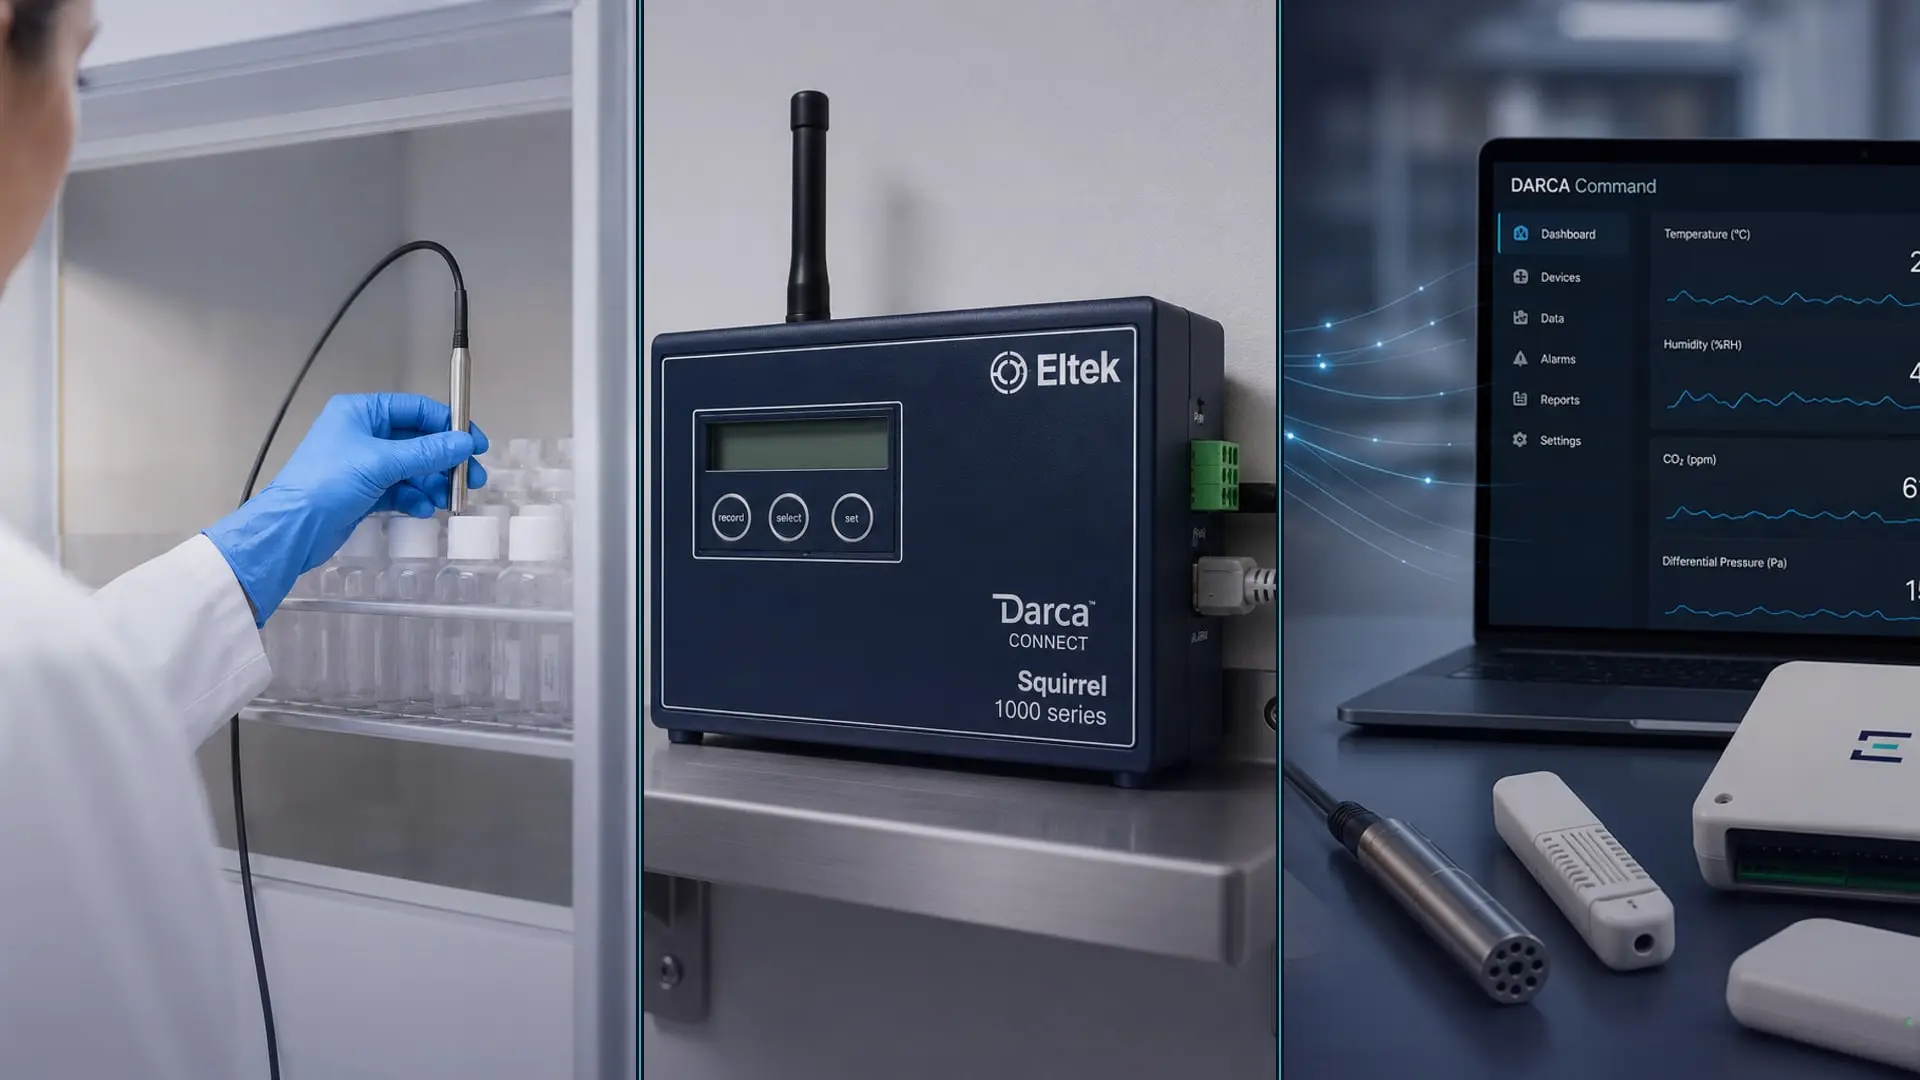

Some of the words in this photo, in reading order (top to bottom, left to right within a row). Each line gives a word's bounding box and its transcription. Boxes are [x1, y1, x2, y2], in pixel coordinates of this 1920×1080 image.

[1511, 177, 1570, 194] DARCA
[1575, 177, 1657, 195] Command
[1541, 228, 1597, 241] Dashboard
[1664, 228, 1728, 242] Temperature
[1540, 271, 1581, 284] Devices
[1540, 312, 1565, 325] Data
[1663, 338, 1708, 353] Humidity
[1711, 339, 1742, 353] (%RH)
[1540, 353, 1577, 366] Alarms
[1037, 350, 1121, 386] Eltek
[1540, 394, 1581, 407] Reports
[1540, 434, 1582, 449] Settings
[1687, 454, 1717, 467] (ppm)
[1902, 476, 1920, 500] 6
[718, 513, 745, 523] record
[776, 513, 802, 523] select
[844, 514, 859, 524] set
[1662, 555, 1718, 568] Differential
[1719, 556, 1765, 569] Pressure
[1766, 556, 1788, 570] (Pa)
[1905, 579, 1920, 602] 1
[1009, 632, 1089, 651] CONNECT
[1017, 669, 1107, 698] Squirrel
[995, 699, 1041, 721] 1000
[1047, 705, 1107, 726] series
